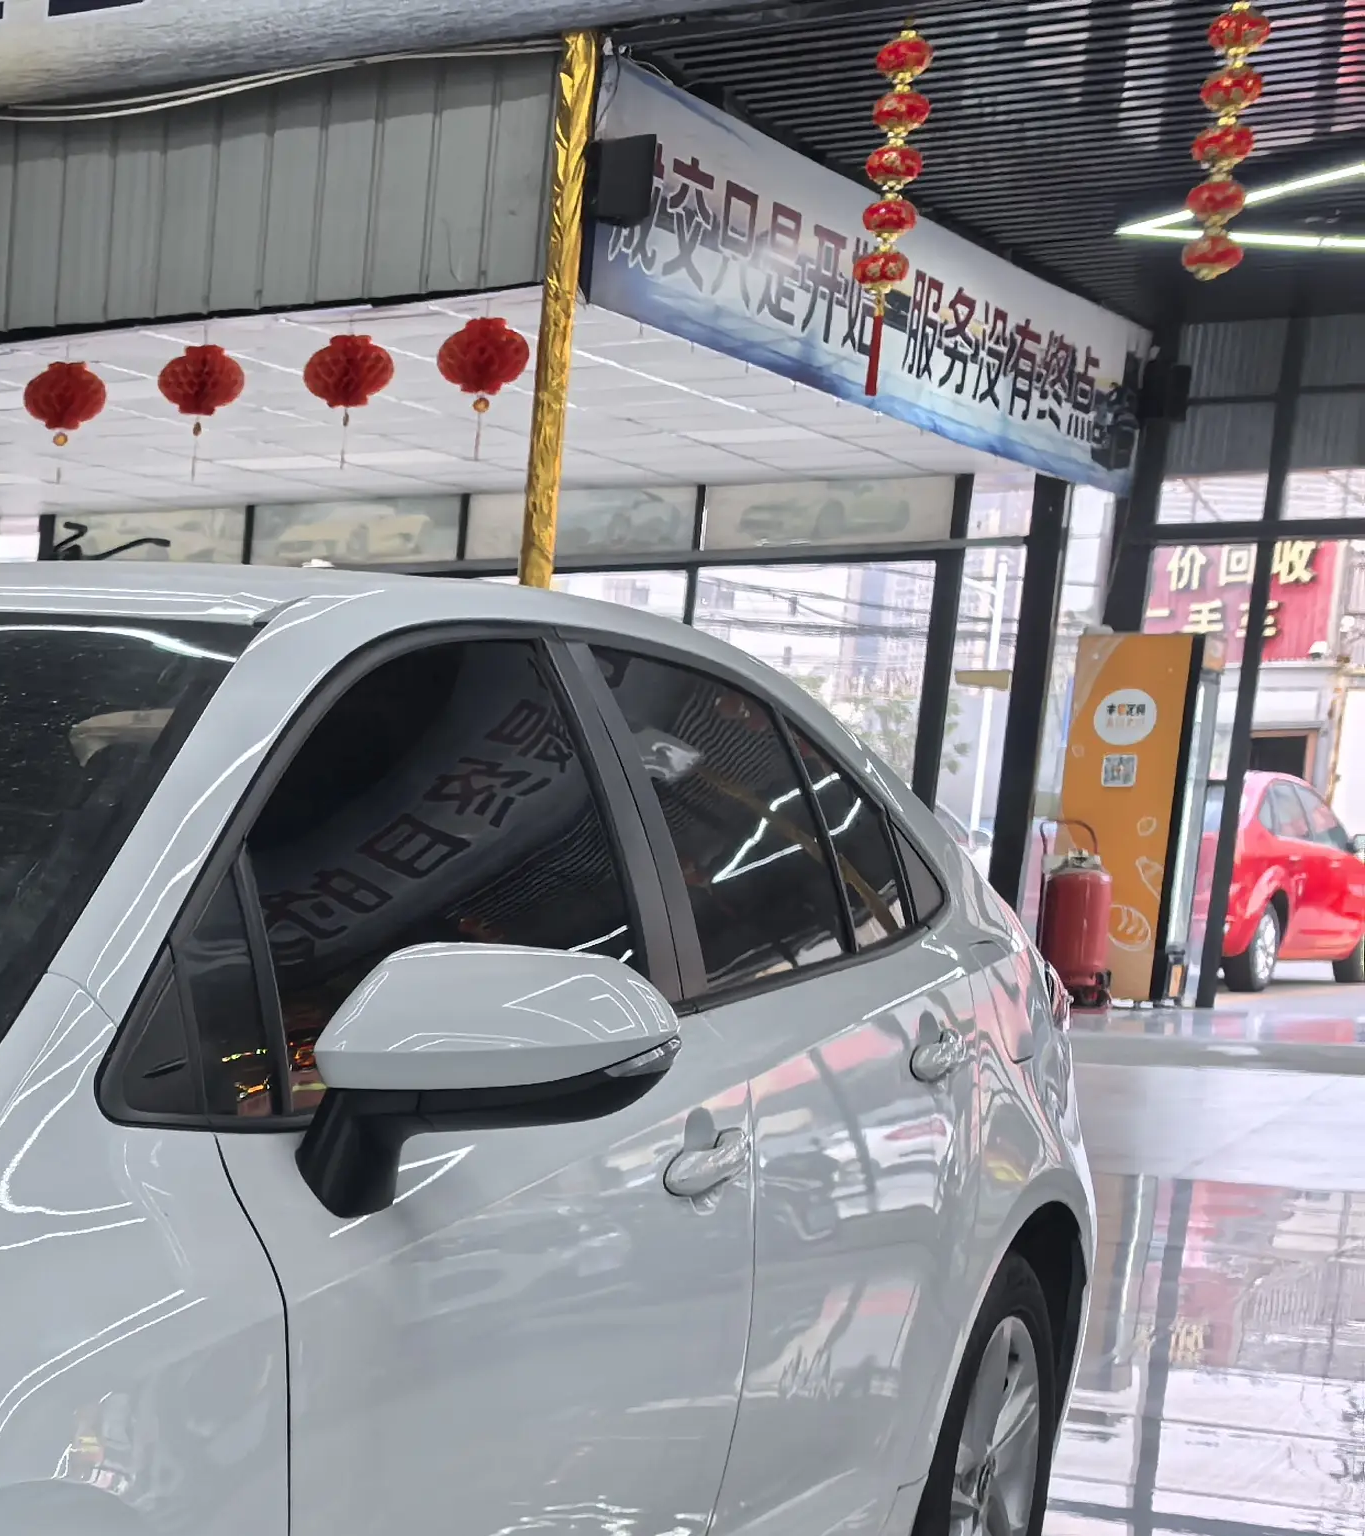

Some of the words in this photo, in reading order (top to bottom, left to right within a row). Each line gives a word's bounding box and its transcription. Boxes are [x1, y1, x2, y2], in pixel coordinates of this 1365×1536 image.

[902, 269, 1100, 443] 服务没有终点
